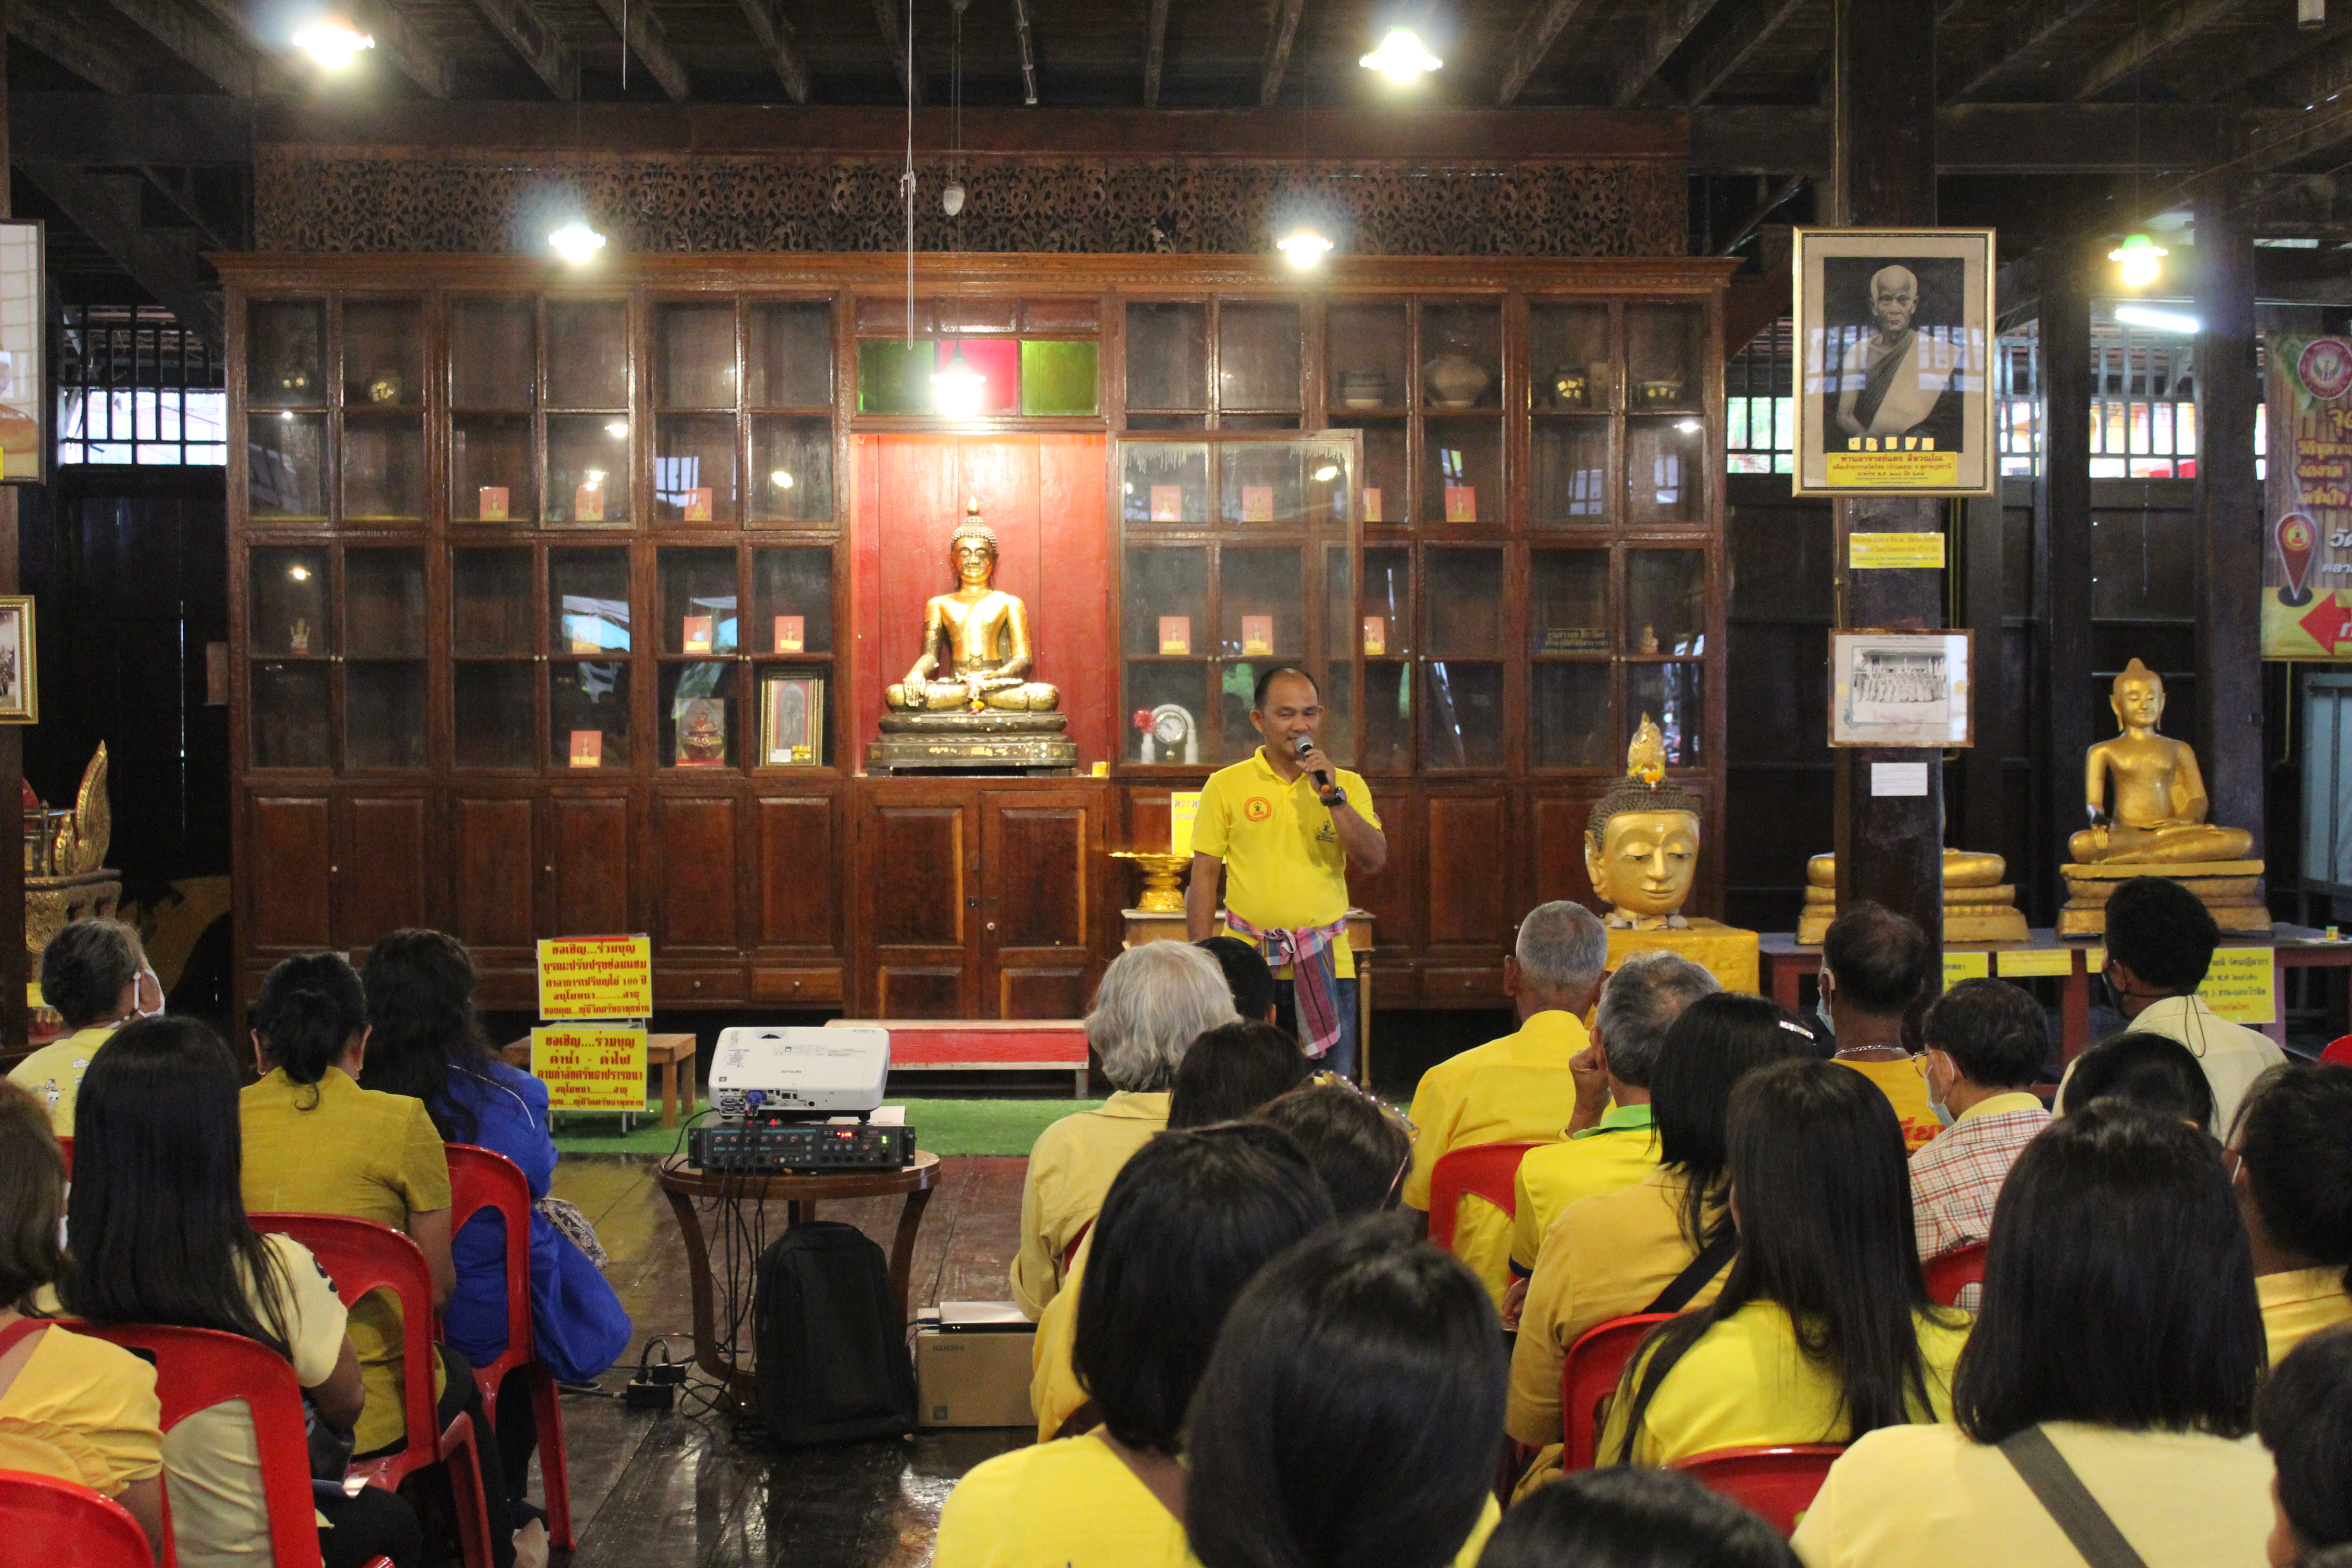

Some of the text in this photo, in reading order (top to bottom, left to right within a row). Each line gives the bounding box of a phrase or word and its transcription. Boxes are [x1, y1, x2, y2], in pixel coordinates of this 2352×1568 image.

[641, 975, 647, 985] ปี
[550, 1049, 579, 1064] ค่าน้ำ
[600, 1050, 631, 1064] ค่าไฟ
